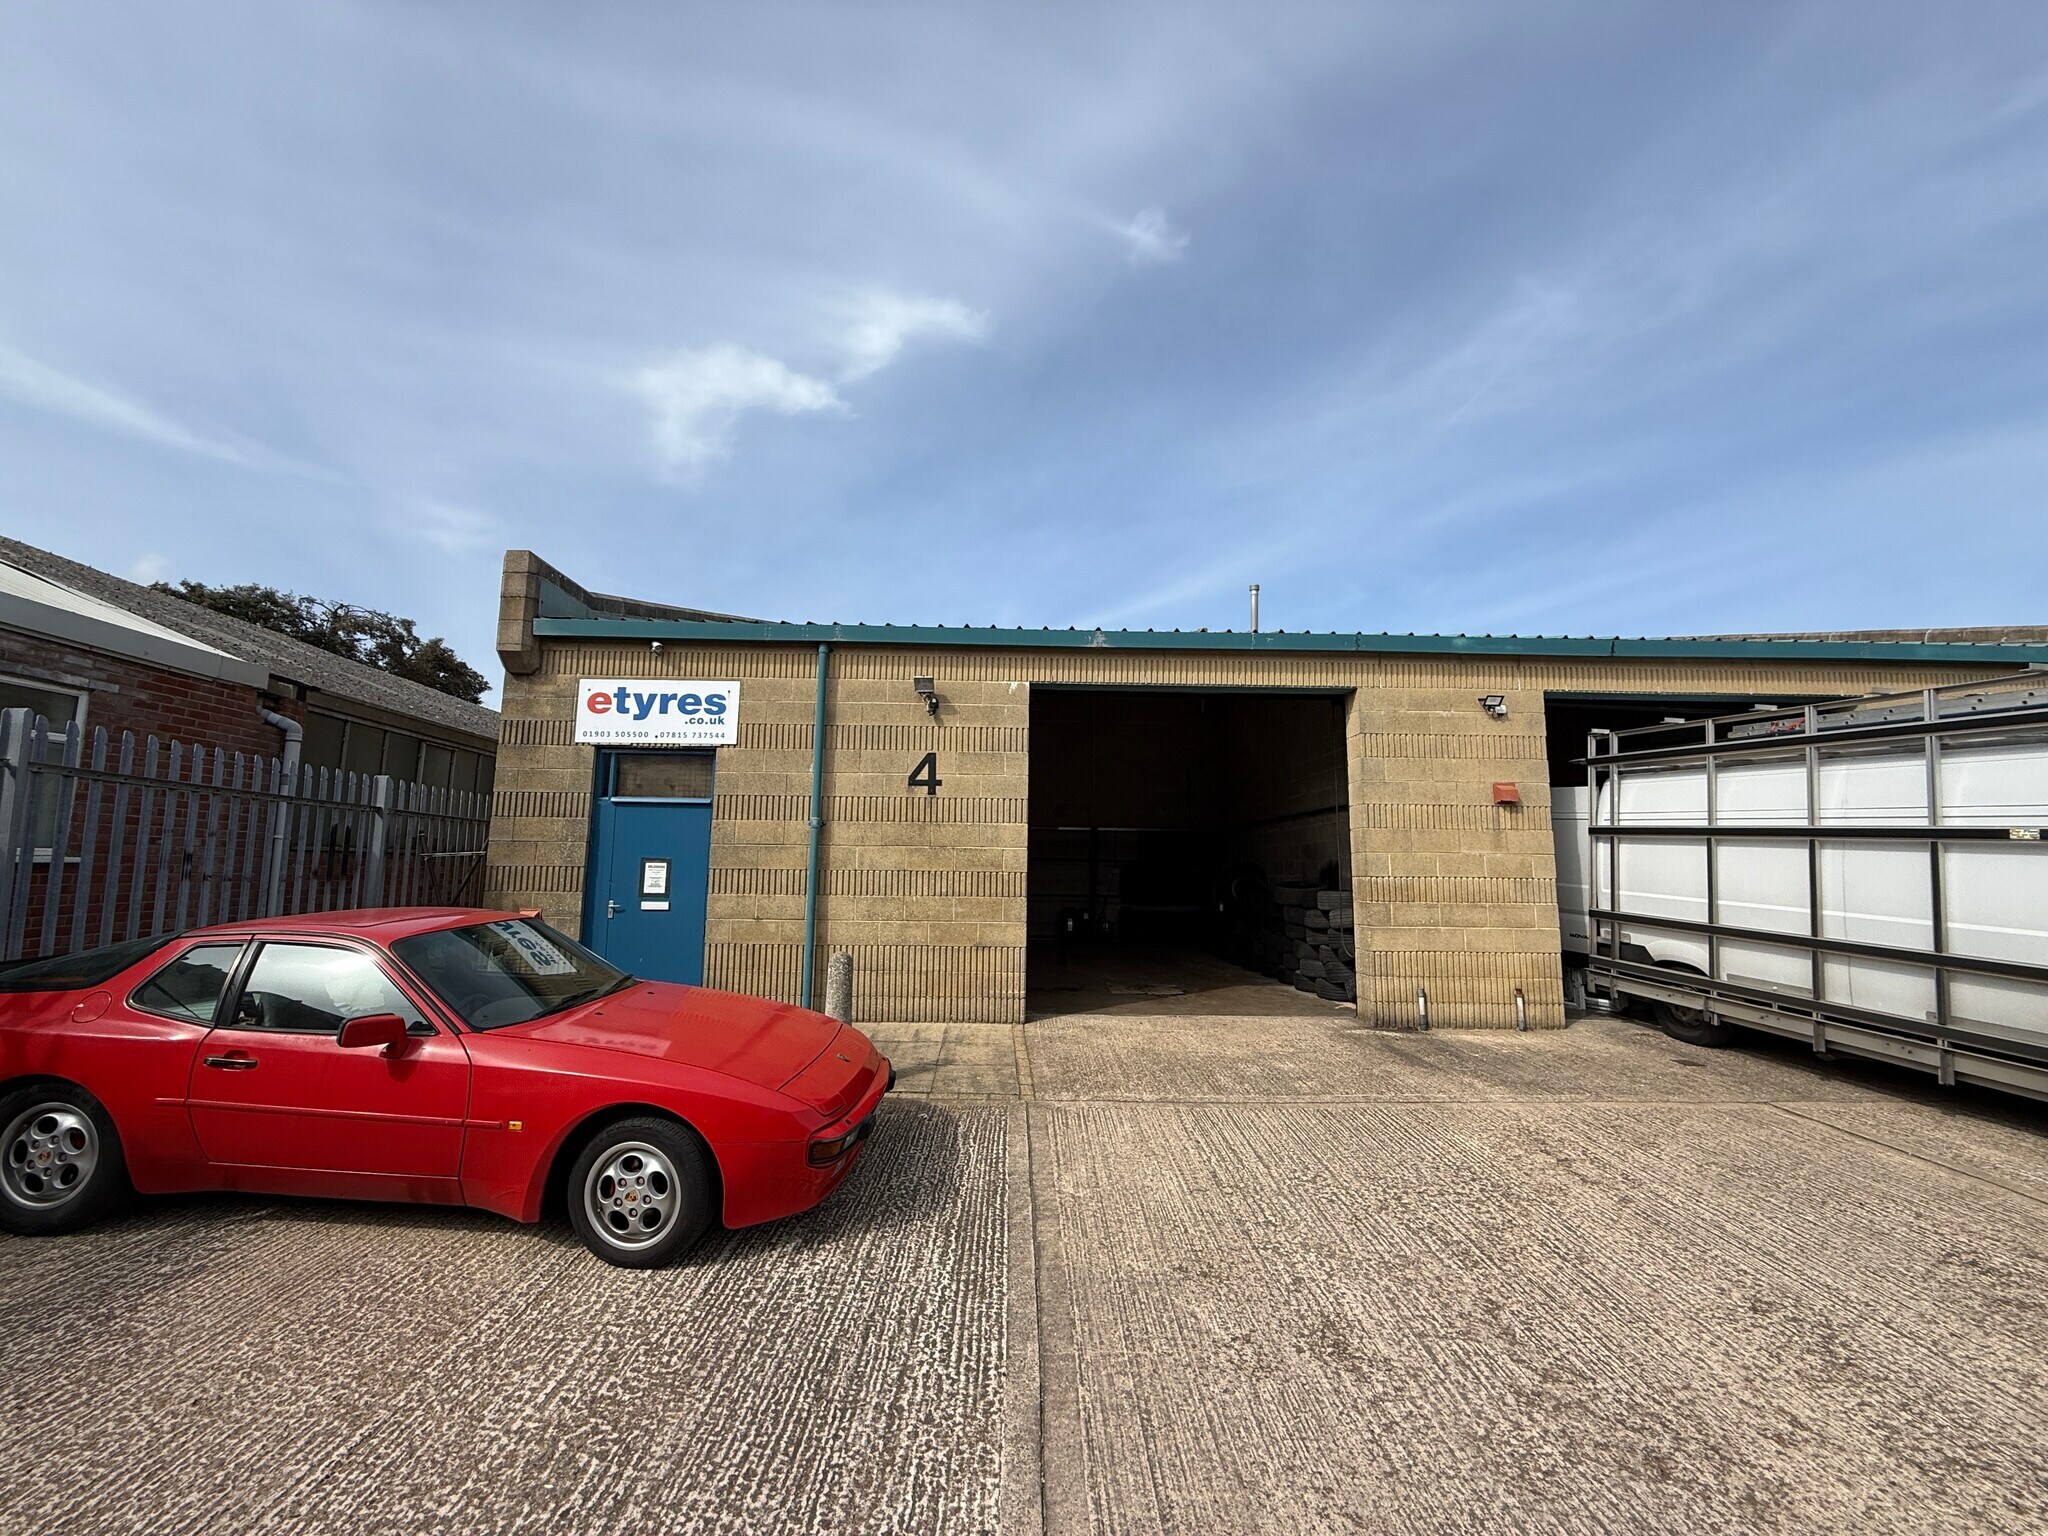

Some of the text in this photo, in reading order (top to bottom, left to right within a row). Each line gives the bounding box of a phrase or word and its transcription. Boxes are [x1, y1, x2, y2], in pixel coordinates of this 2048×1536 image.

[587, 687, 727, 720] etyres
[684, 716, 725, 725] .co.uk
[908, 753, 942, 795] 4
